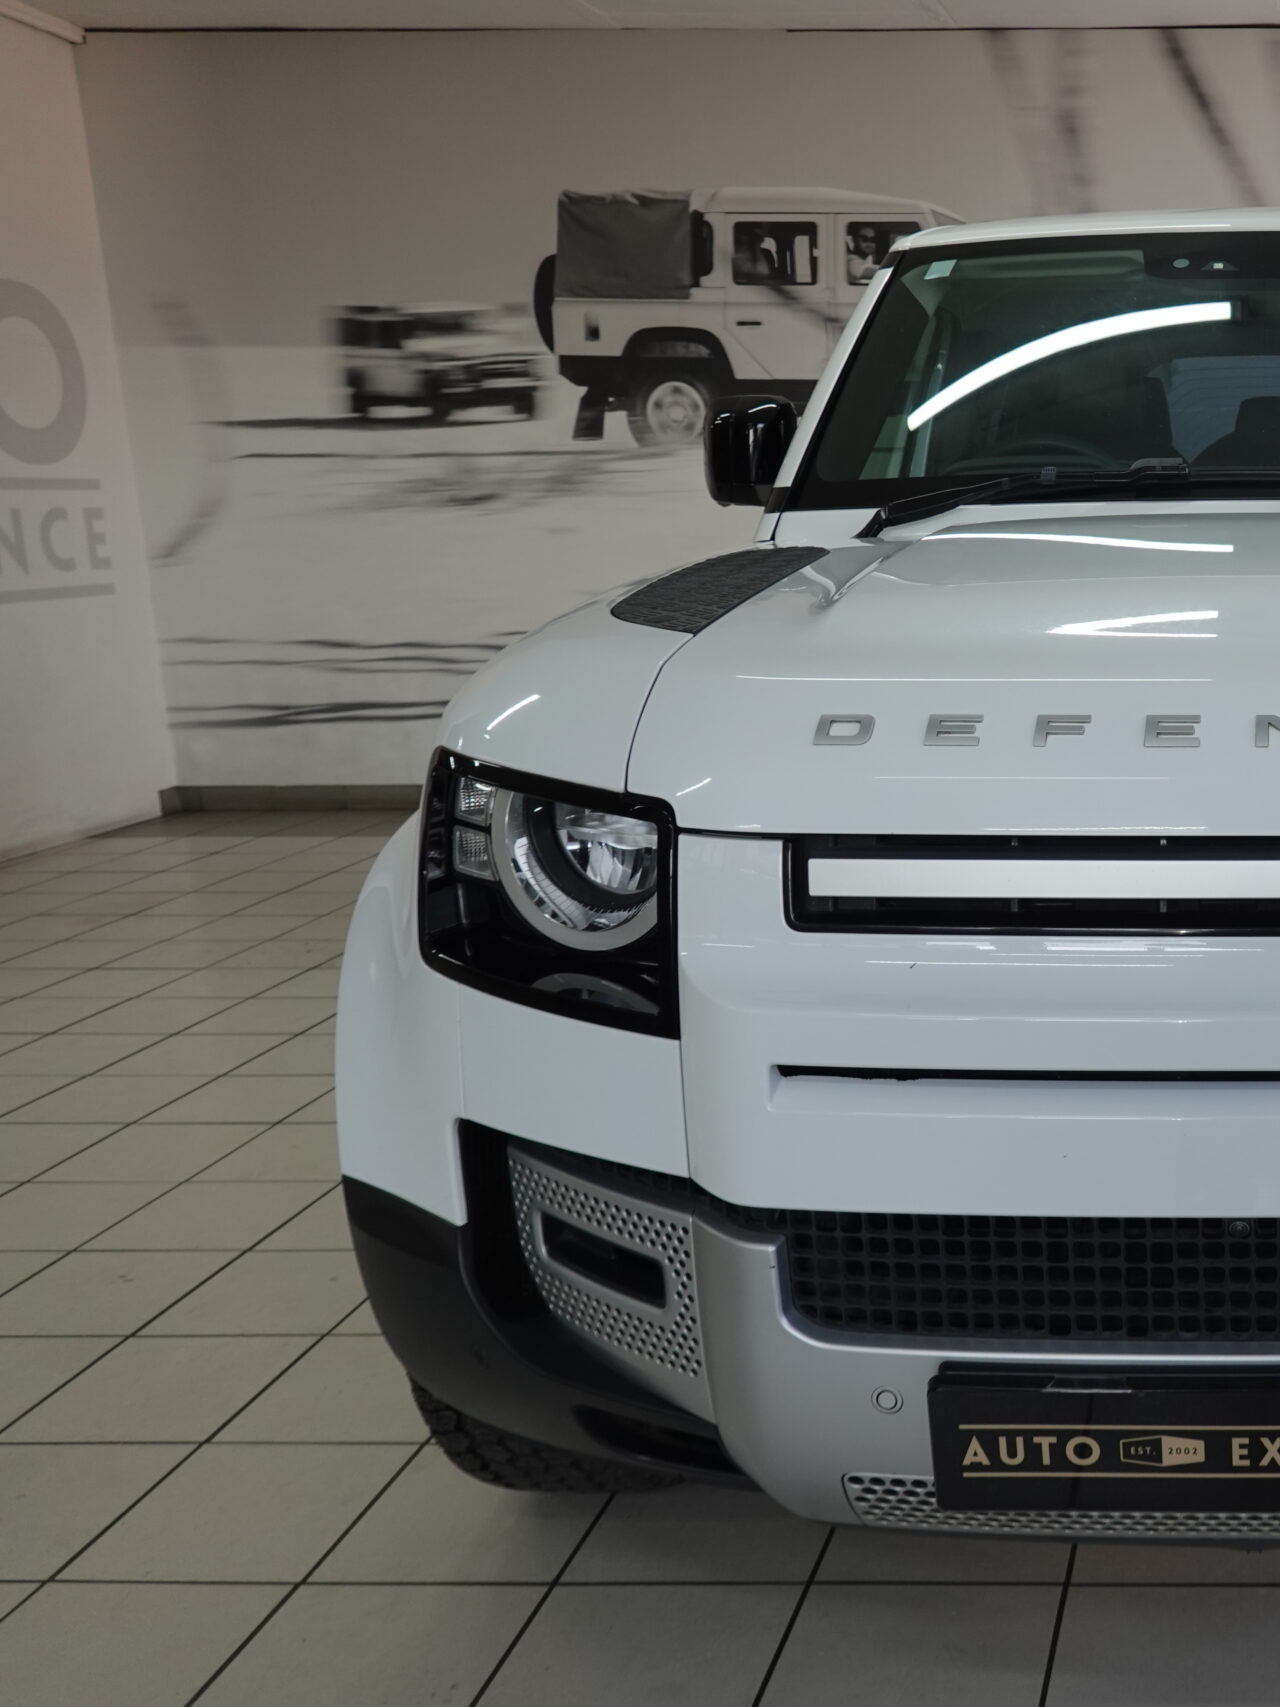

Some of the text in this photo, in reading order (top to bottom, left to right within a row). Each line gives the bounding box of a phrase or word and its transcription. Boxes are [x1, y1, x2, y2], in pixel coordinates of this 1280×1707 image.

[962, 1435, 1102, 1467] AUTO
[1130, 1446, 1157, 1456] EST.
[1168, 1447, 1198, 1456] 2002
